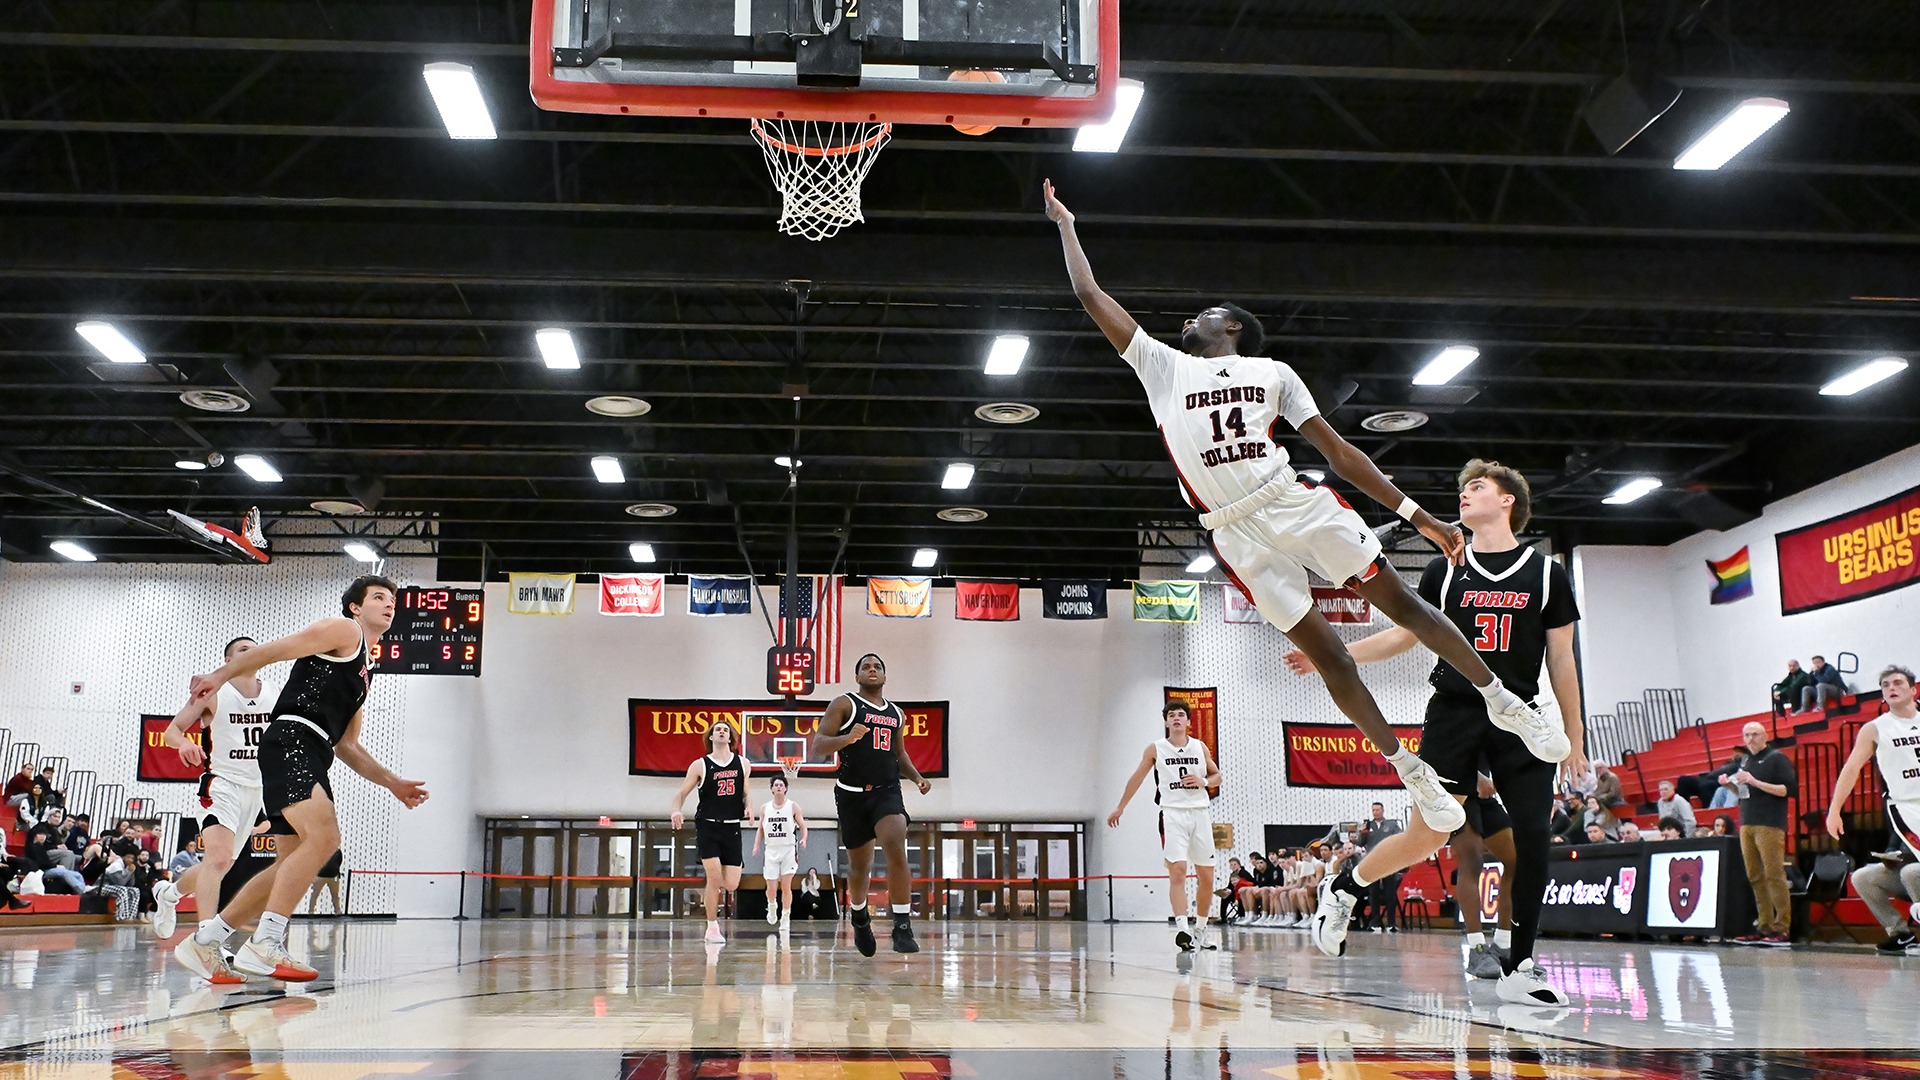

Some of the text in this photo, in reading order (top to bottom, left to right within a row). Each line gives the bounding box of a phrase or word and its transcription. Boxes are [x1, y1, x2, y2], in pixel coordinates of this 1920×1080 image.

[1185, 385, 1266, 410] URSINUS
[1209, 406, 1247, 443] 14
[1823, 507, 1920, 563] URSINUS
[1838, 539, 1914, 584] BEARS
[518, 587, 565, 602] BRYN MAWR
[874, 590, 924, 605] GETTYSBURG
[1061, 584, 1089, 598] JOHNS
[405, 591, 449, 610] 11:52
[614, 597, 650, 607] COLLEGE
[964, 594, 1011, 609] HAVERFORD
[1317, 597, 1366, 613] SWARTHMORE
[1459, 591, 1530, 609] FORDS
[468, 602, 480, 621] 9
[1056, 601, 1093, 616] HOPKINS
[411, 621, 435, 629] period
[1474, 613, 1513, 652] 31
[390, 644, 400, 660] 6
[442, 645, 475, 661] 5 2
[778, 670, 804, 691] 26
[229, 712, 271, 724] URSINU
[864, 713, 898, 728] FORDS
[243, 726, 264, 747] 10
[873, 726, 892, 751] 13
[1292, 736, 1357, 752] URSINUS
[229, 749, 257, 760] COLL
[1165, 757, 1199, 766] URSINUS
[717, 779, 736, 796] 25
[772, 822, 783, 832] 34
